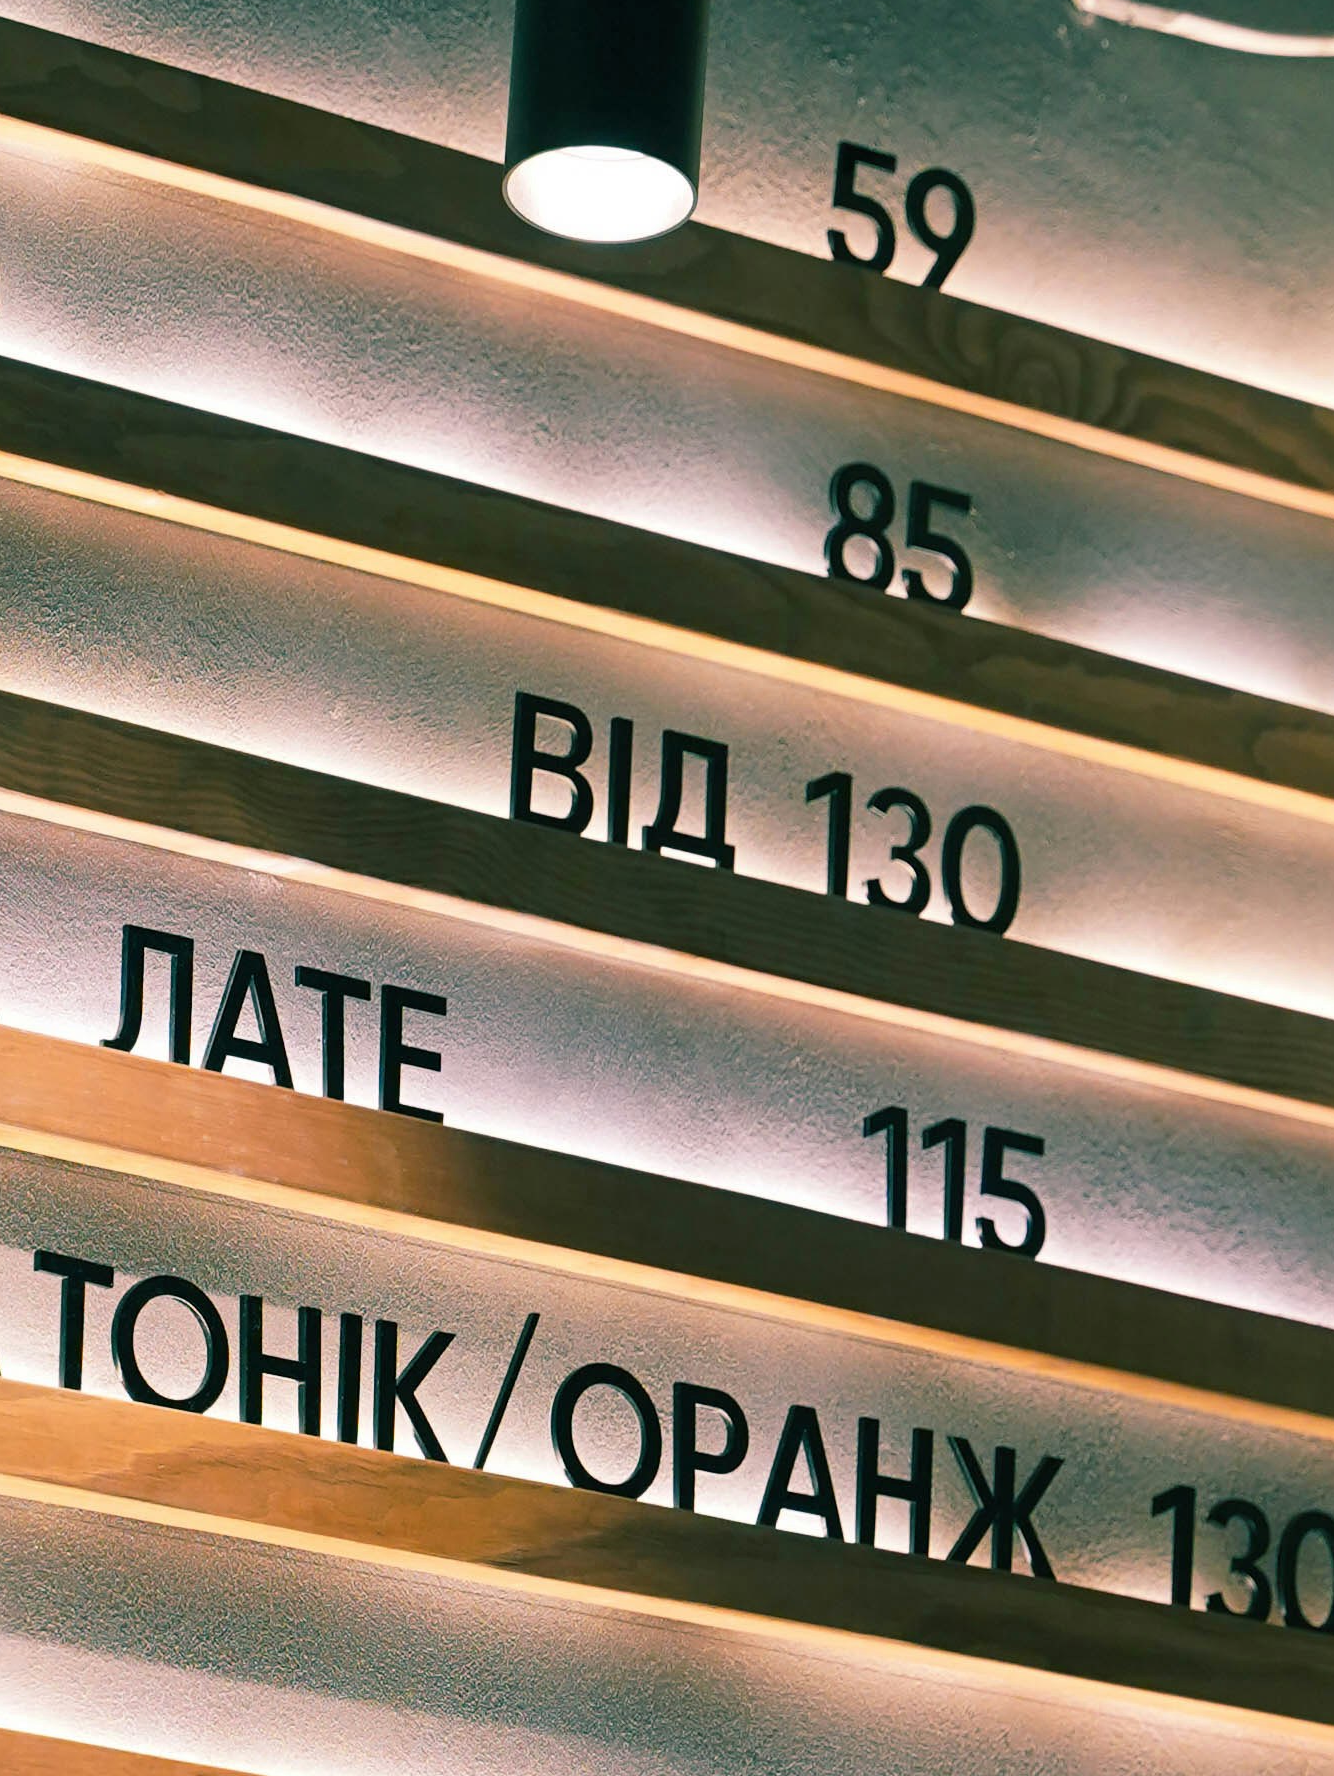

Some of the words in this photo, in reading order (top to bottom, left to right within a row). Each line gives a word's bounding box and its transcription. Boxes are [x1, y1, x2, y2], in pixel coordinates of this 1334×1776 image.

[826, 142, 976, 289] 59
[824, 461, 976, 614] 85
[509, 691, 737, 872] ВІД
[805, 771, 1023, 939] 130
[99, 924, 448, 1125] ЛАТЕ
[861, 1104, 1048, 1261] 115
